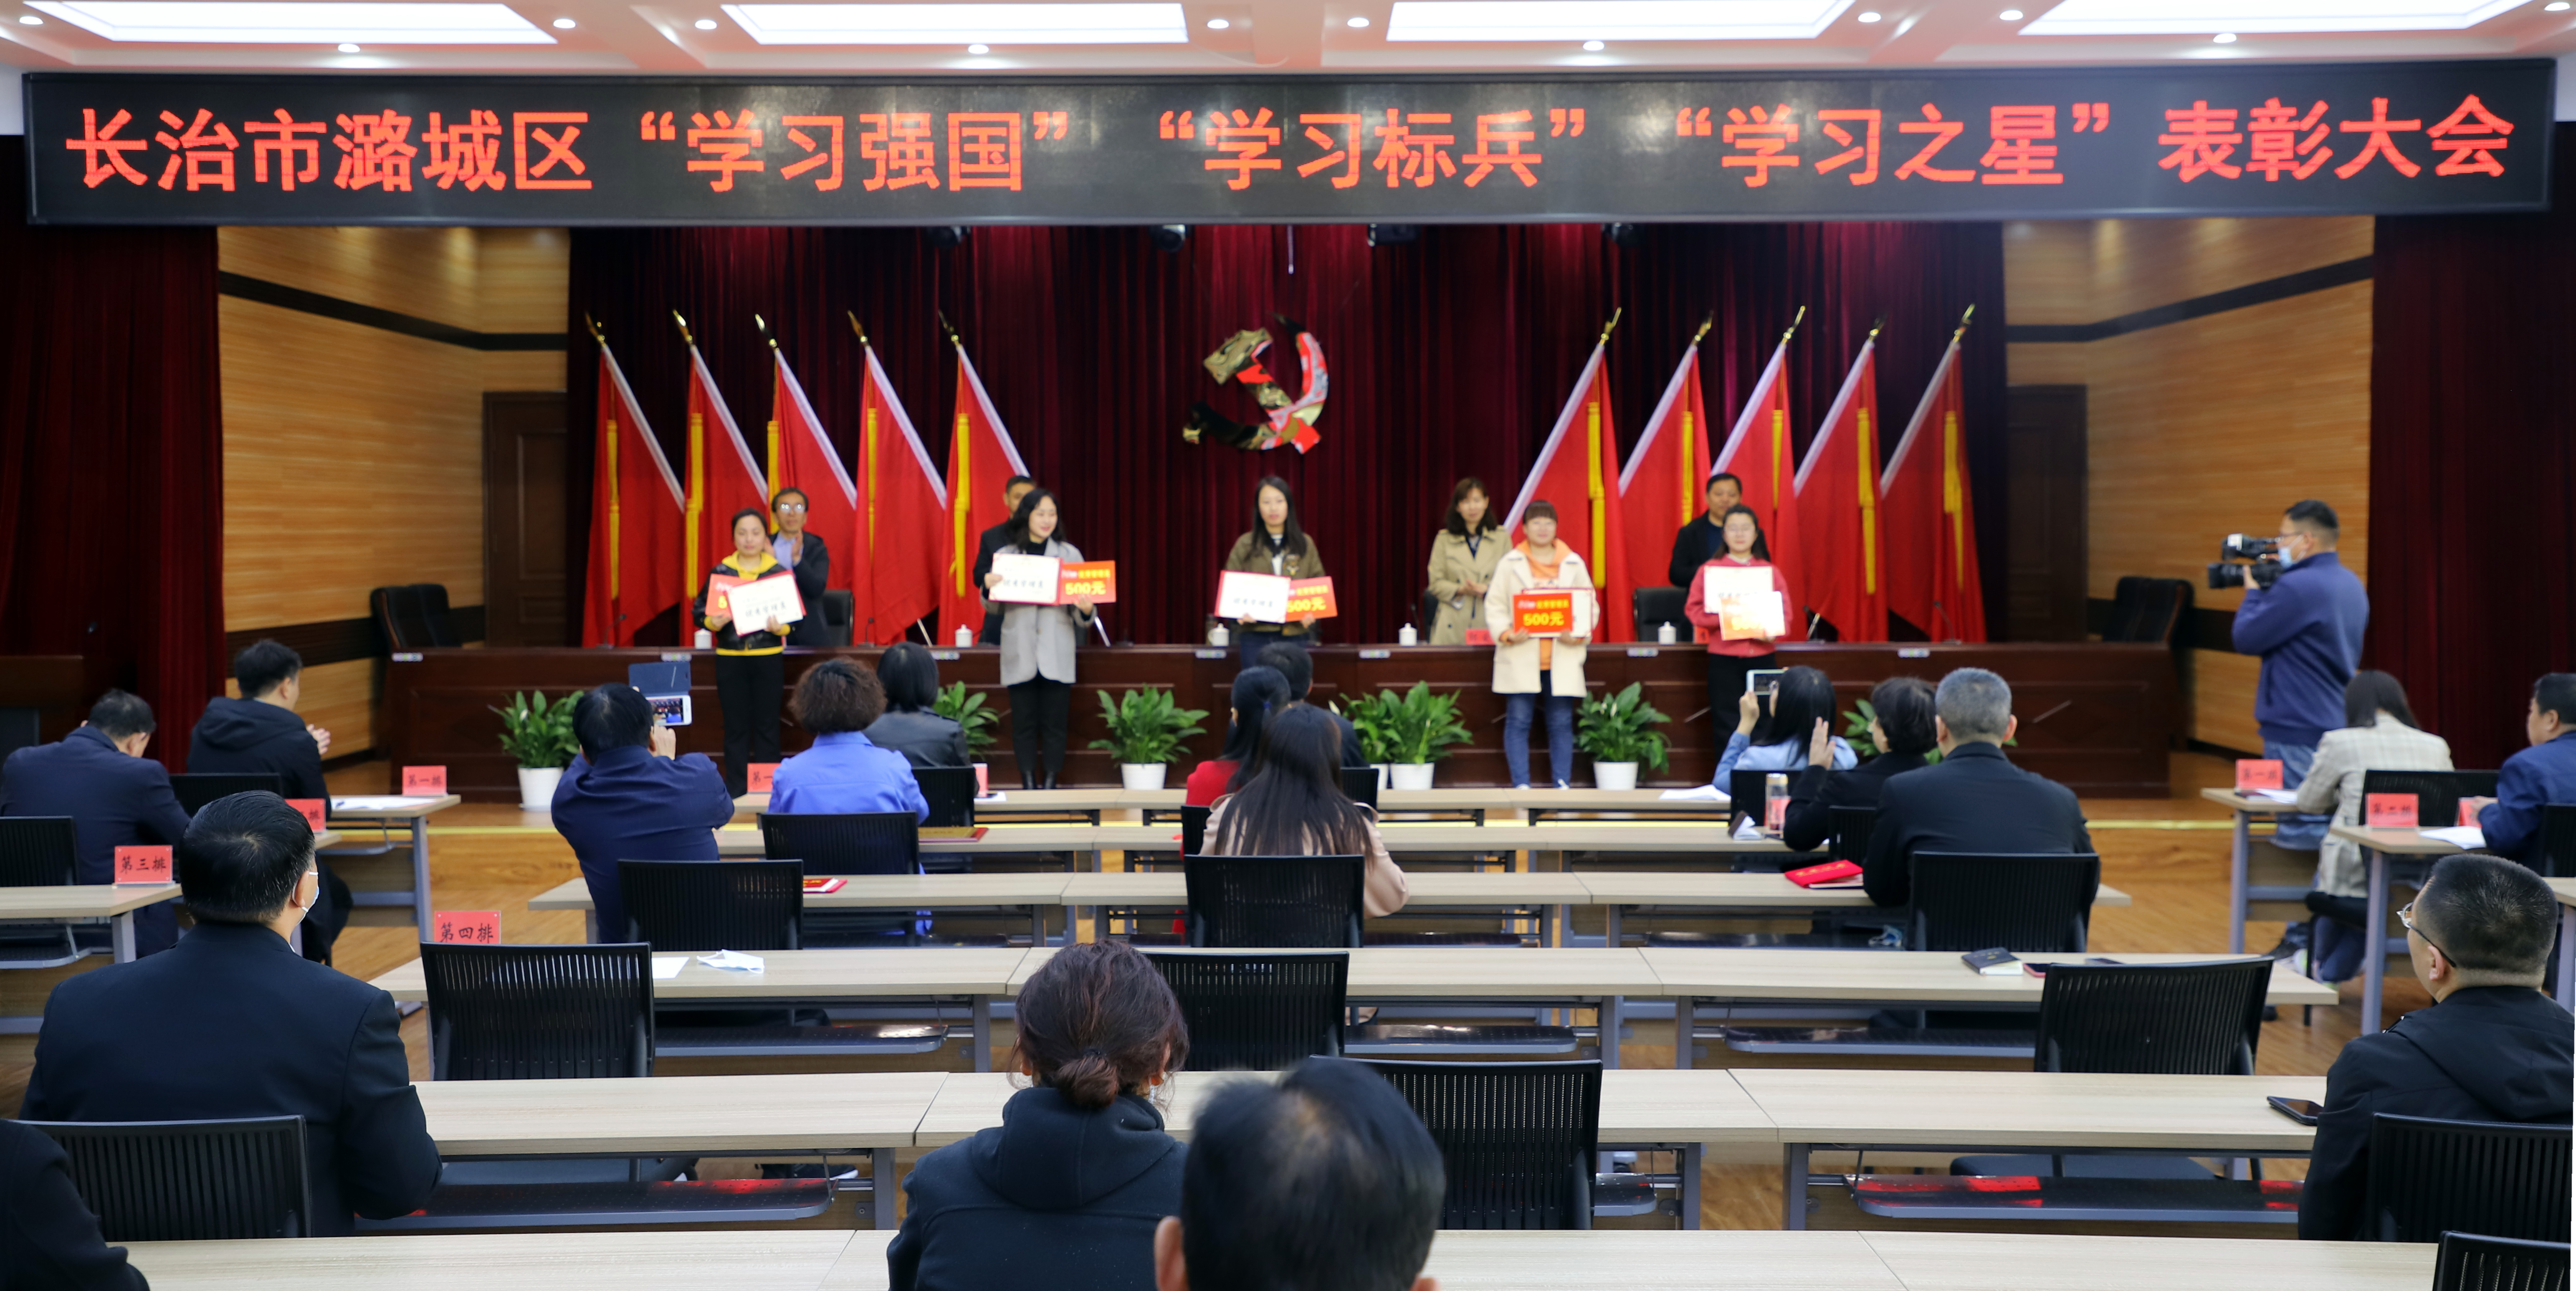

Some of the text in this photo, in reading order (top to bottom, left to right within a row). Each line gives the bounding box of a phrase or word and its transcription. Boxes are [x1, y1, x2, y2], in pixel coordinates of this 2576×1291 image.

[1065, 580, 1106, 595] 500元
[1287, 597, 1326, 613] 500元
[1523, 611, 1565, 627] 500元
[752, 771, 773, 785] 第一
[120, 855, 166, 875] 第三排
[440, 921, 493, 944] 第四排
